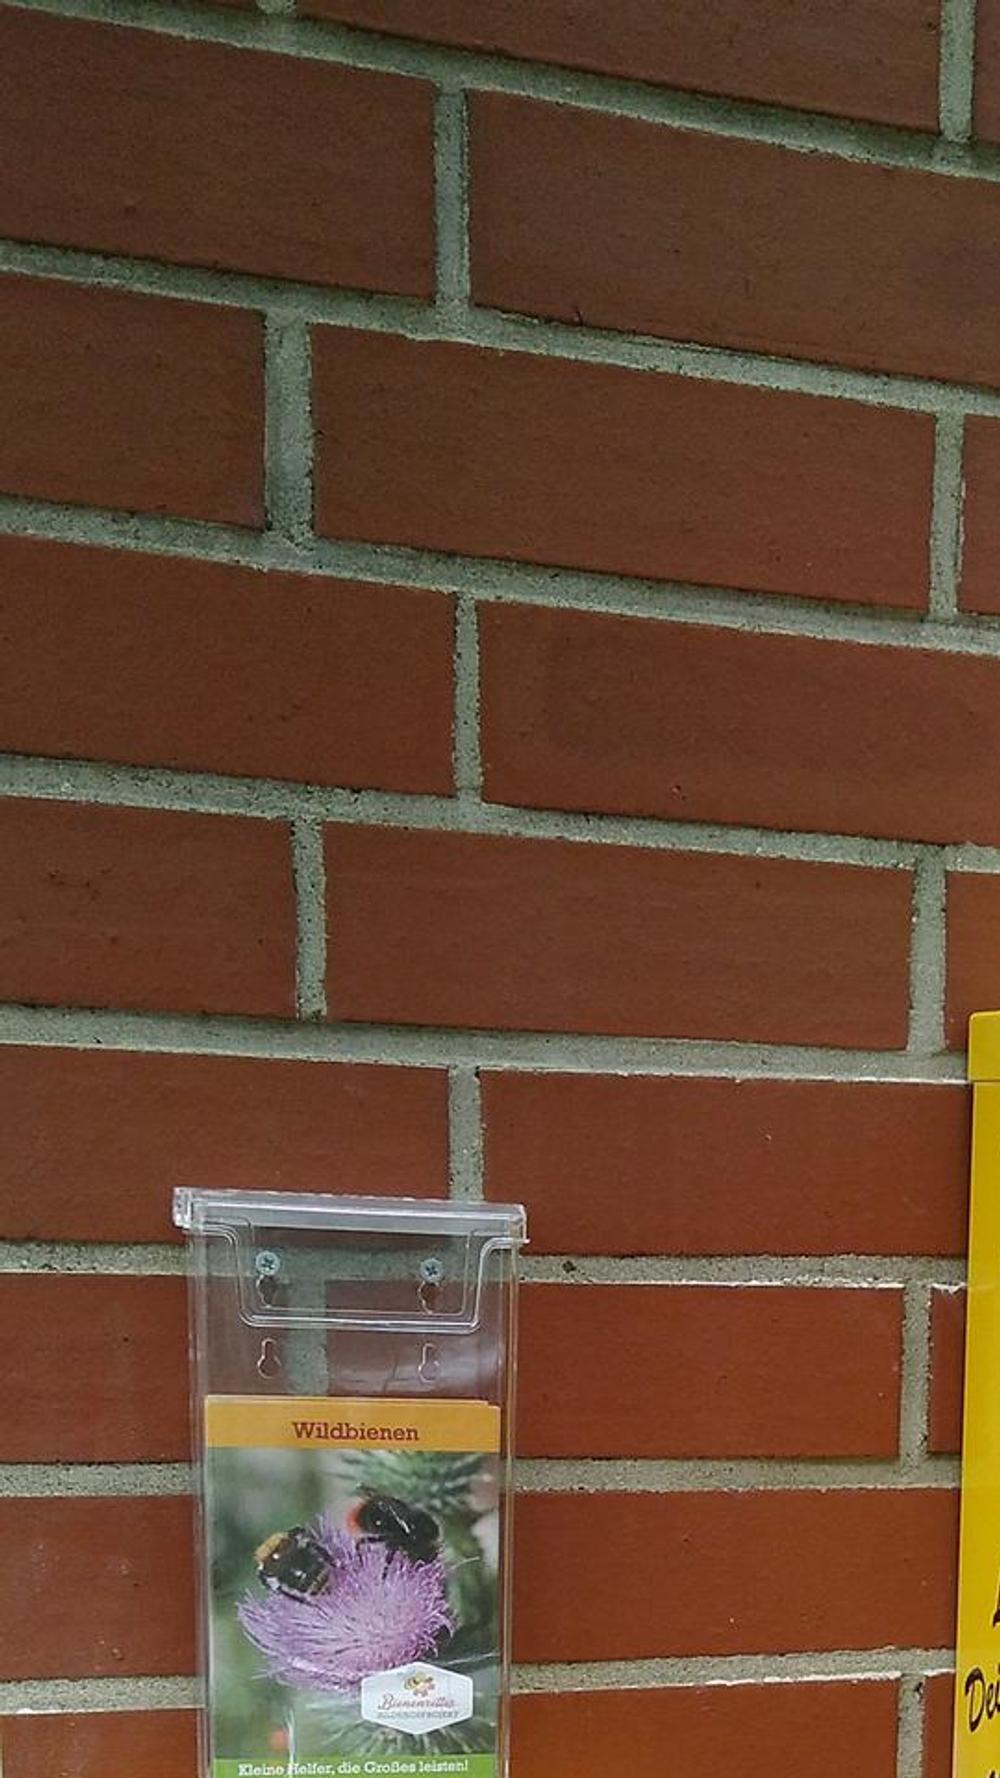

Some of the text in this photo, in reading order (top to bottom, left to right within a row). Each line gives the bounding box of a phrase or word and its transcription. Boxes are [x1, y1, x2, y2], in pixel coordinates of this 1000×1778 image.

[292, 1422, 420, 1441] Wildbienen
[238, 1759, 468, 1776] Kleine Helfer, die Großes leisten!
